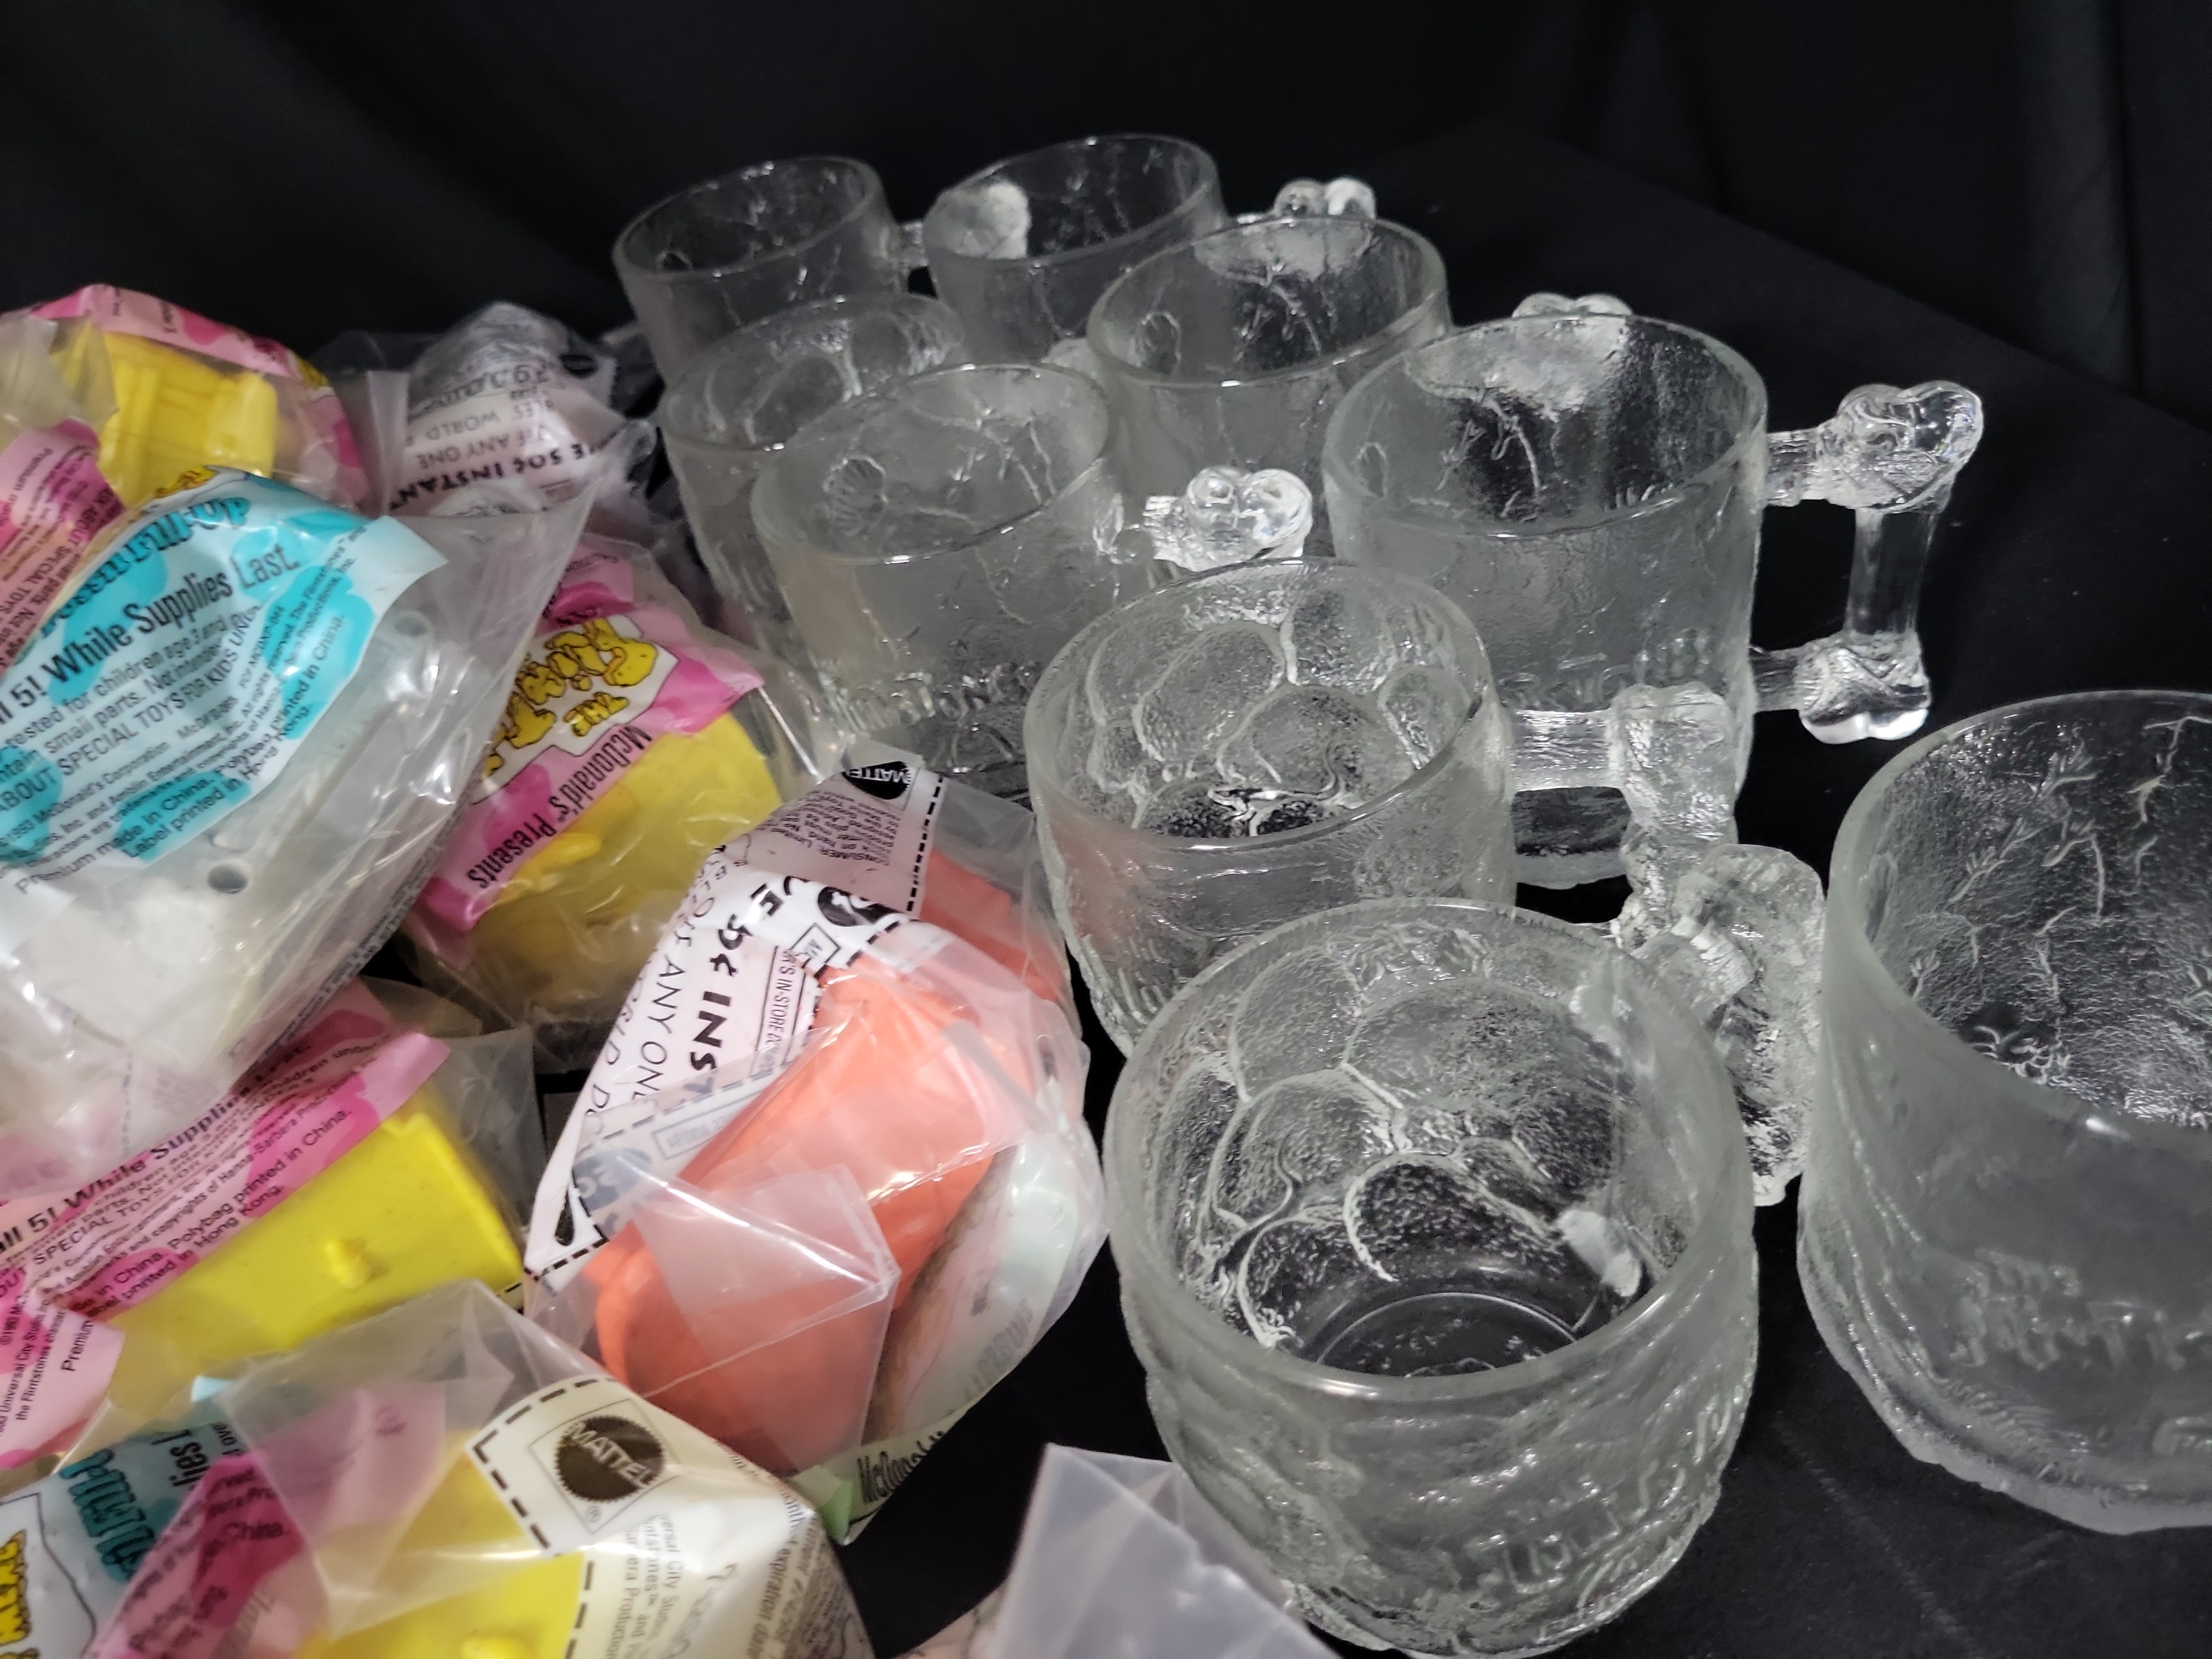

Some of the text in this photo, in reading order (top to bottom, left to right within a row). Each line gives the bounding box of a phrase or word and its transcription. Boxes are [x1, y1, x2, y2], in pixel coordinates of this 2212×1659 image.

[40, 623, 134, 683] While
[123, 572, 232, 634] Supplies
[44, 717, 95, 754] small
[56, 722, 139, 776] SPECIAL
[133, 692, 186, 729] TOYS
[203, 648, 238, 686] KIDS
[62, 692, 91, 715] for
[143, 811, 163, 826] in
[304, 664, 320, 680] in
[849, 768, 910, 784] MATTE
[121, 823, 172, 858] Label
[169, 786, 226, 831] printed
[467, 812, 557, 889] Presents
[647, 953, 686, 1035] ANY
[64, 1160, 147, 1208] While
[168, 1202, 235, 1249] Polybag
[233, 1159, 286, 1204] printed
[284, 1147, 303, 1161] in
[33, 1216, 114, 1265] SPECIAL
[122, 1259, 177, 1300] printed
[193, 1217, 239, 1248] Hong
[568, 1421, 656, 1489] MATTEL
[665, 1560, 683, 1589] City
